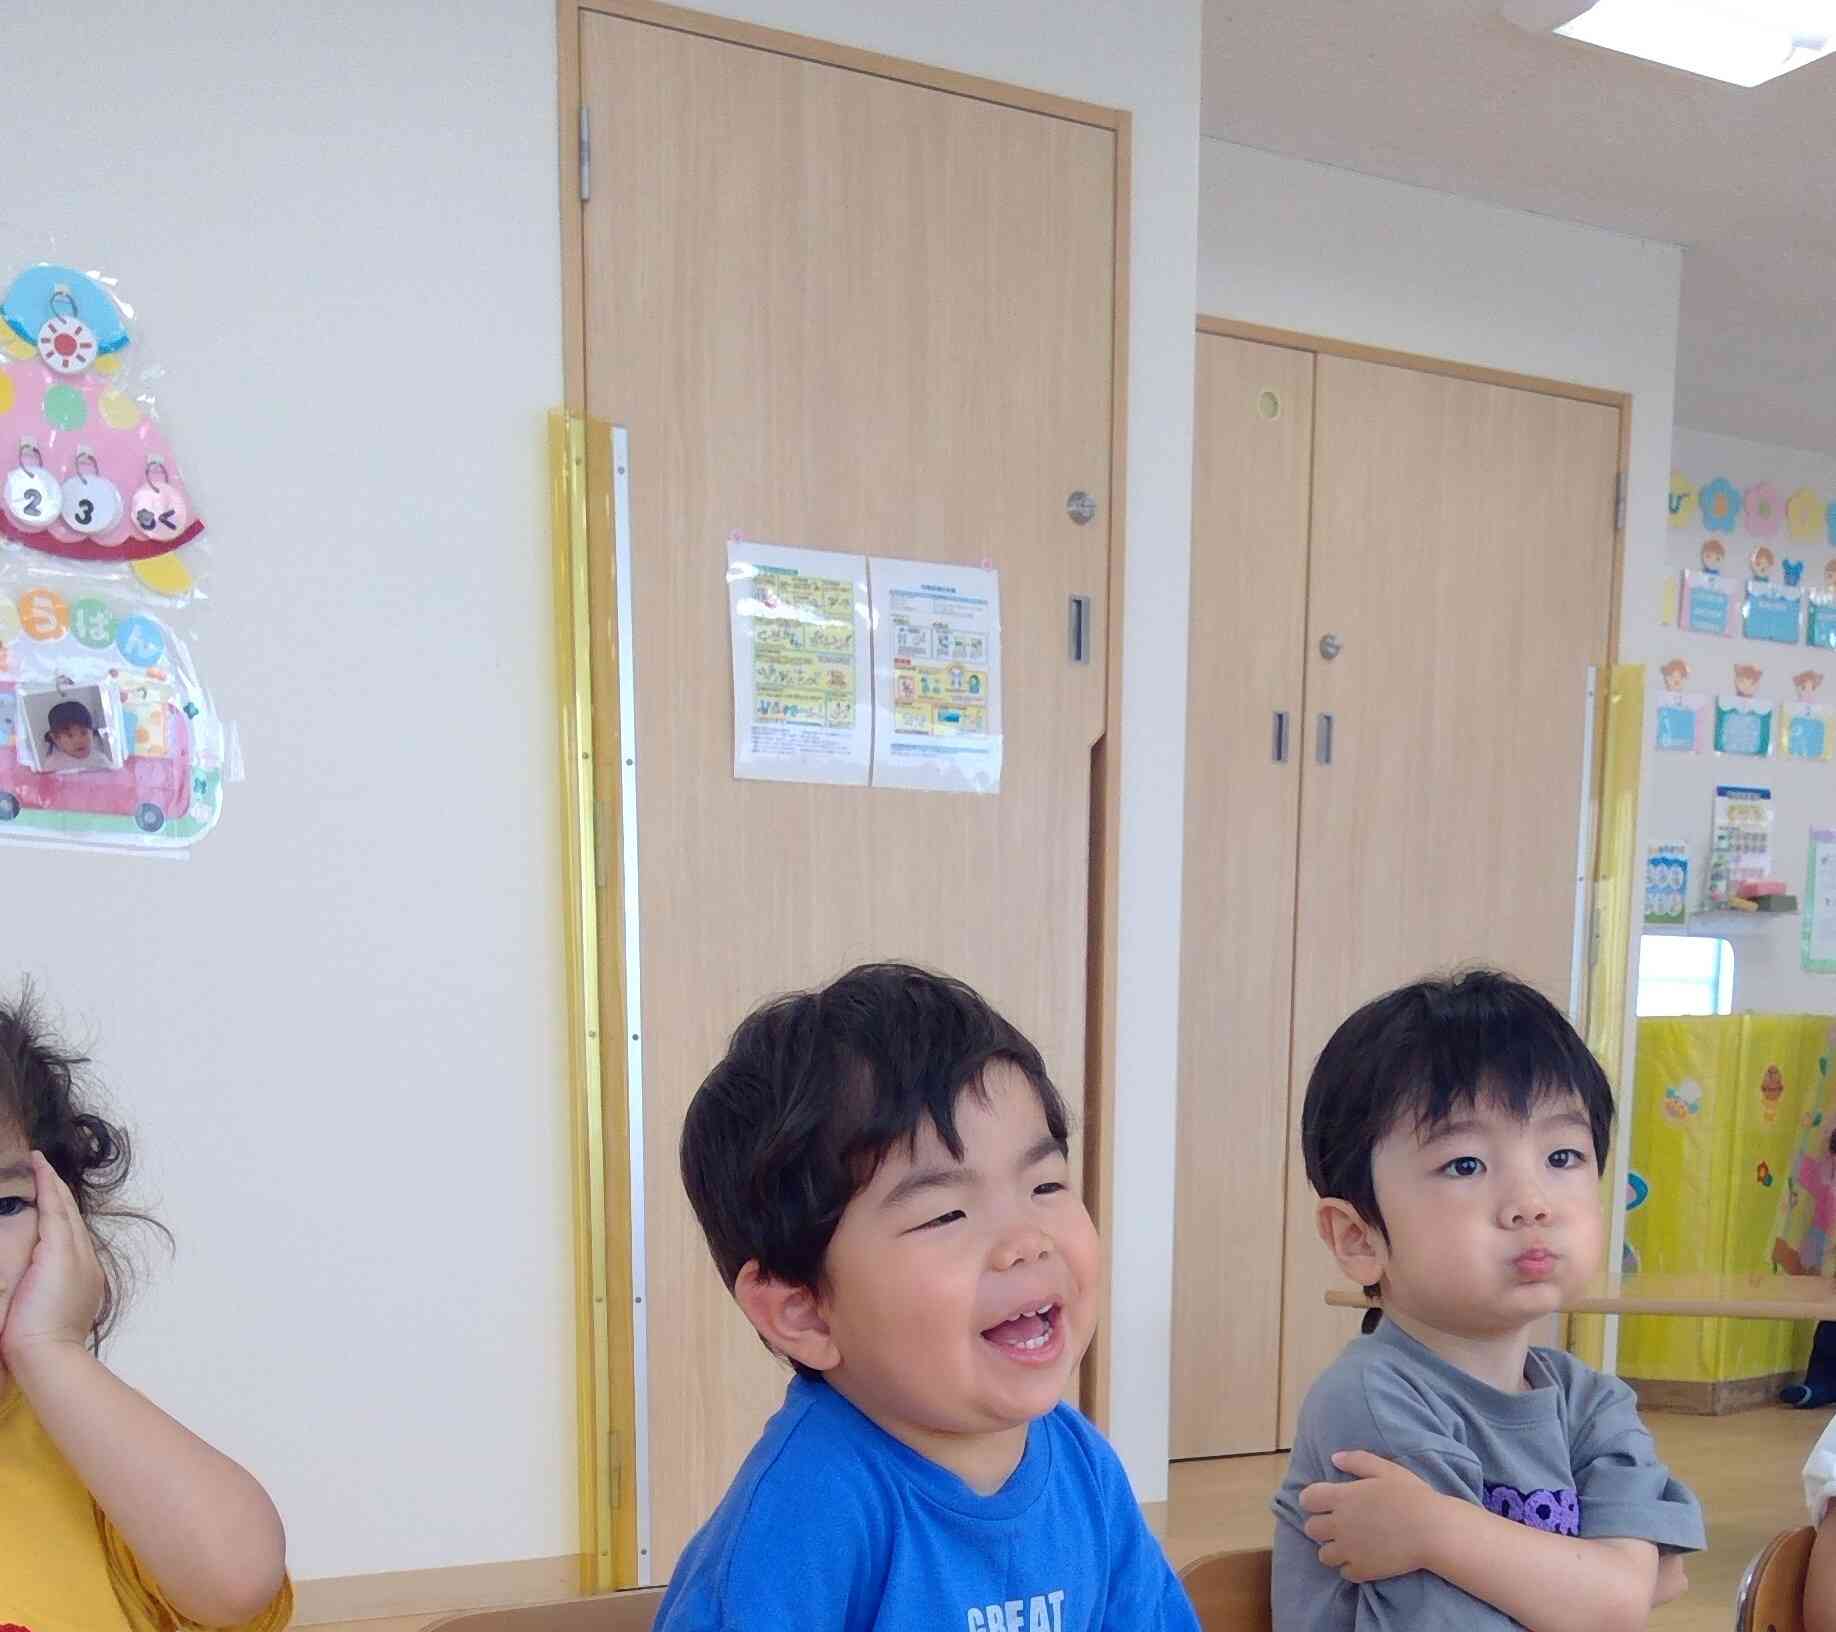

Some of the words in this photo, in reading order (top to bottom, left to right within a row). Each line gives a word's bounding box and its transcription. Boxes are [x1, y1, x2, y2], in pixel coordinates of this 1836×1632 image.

[23, 488, 42, 516] 2
[75, 498, 94, 525] 3
[0, 597, 157, 652] うばん
